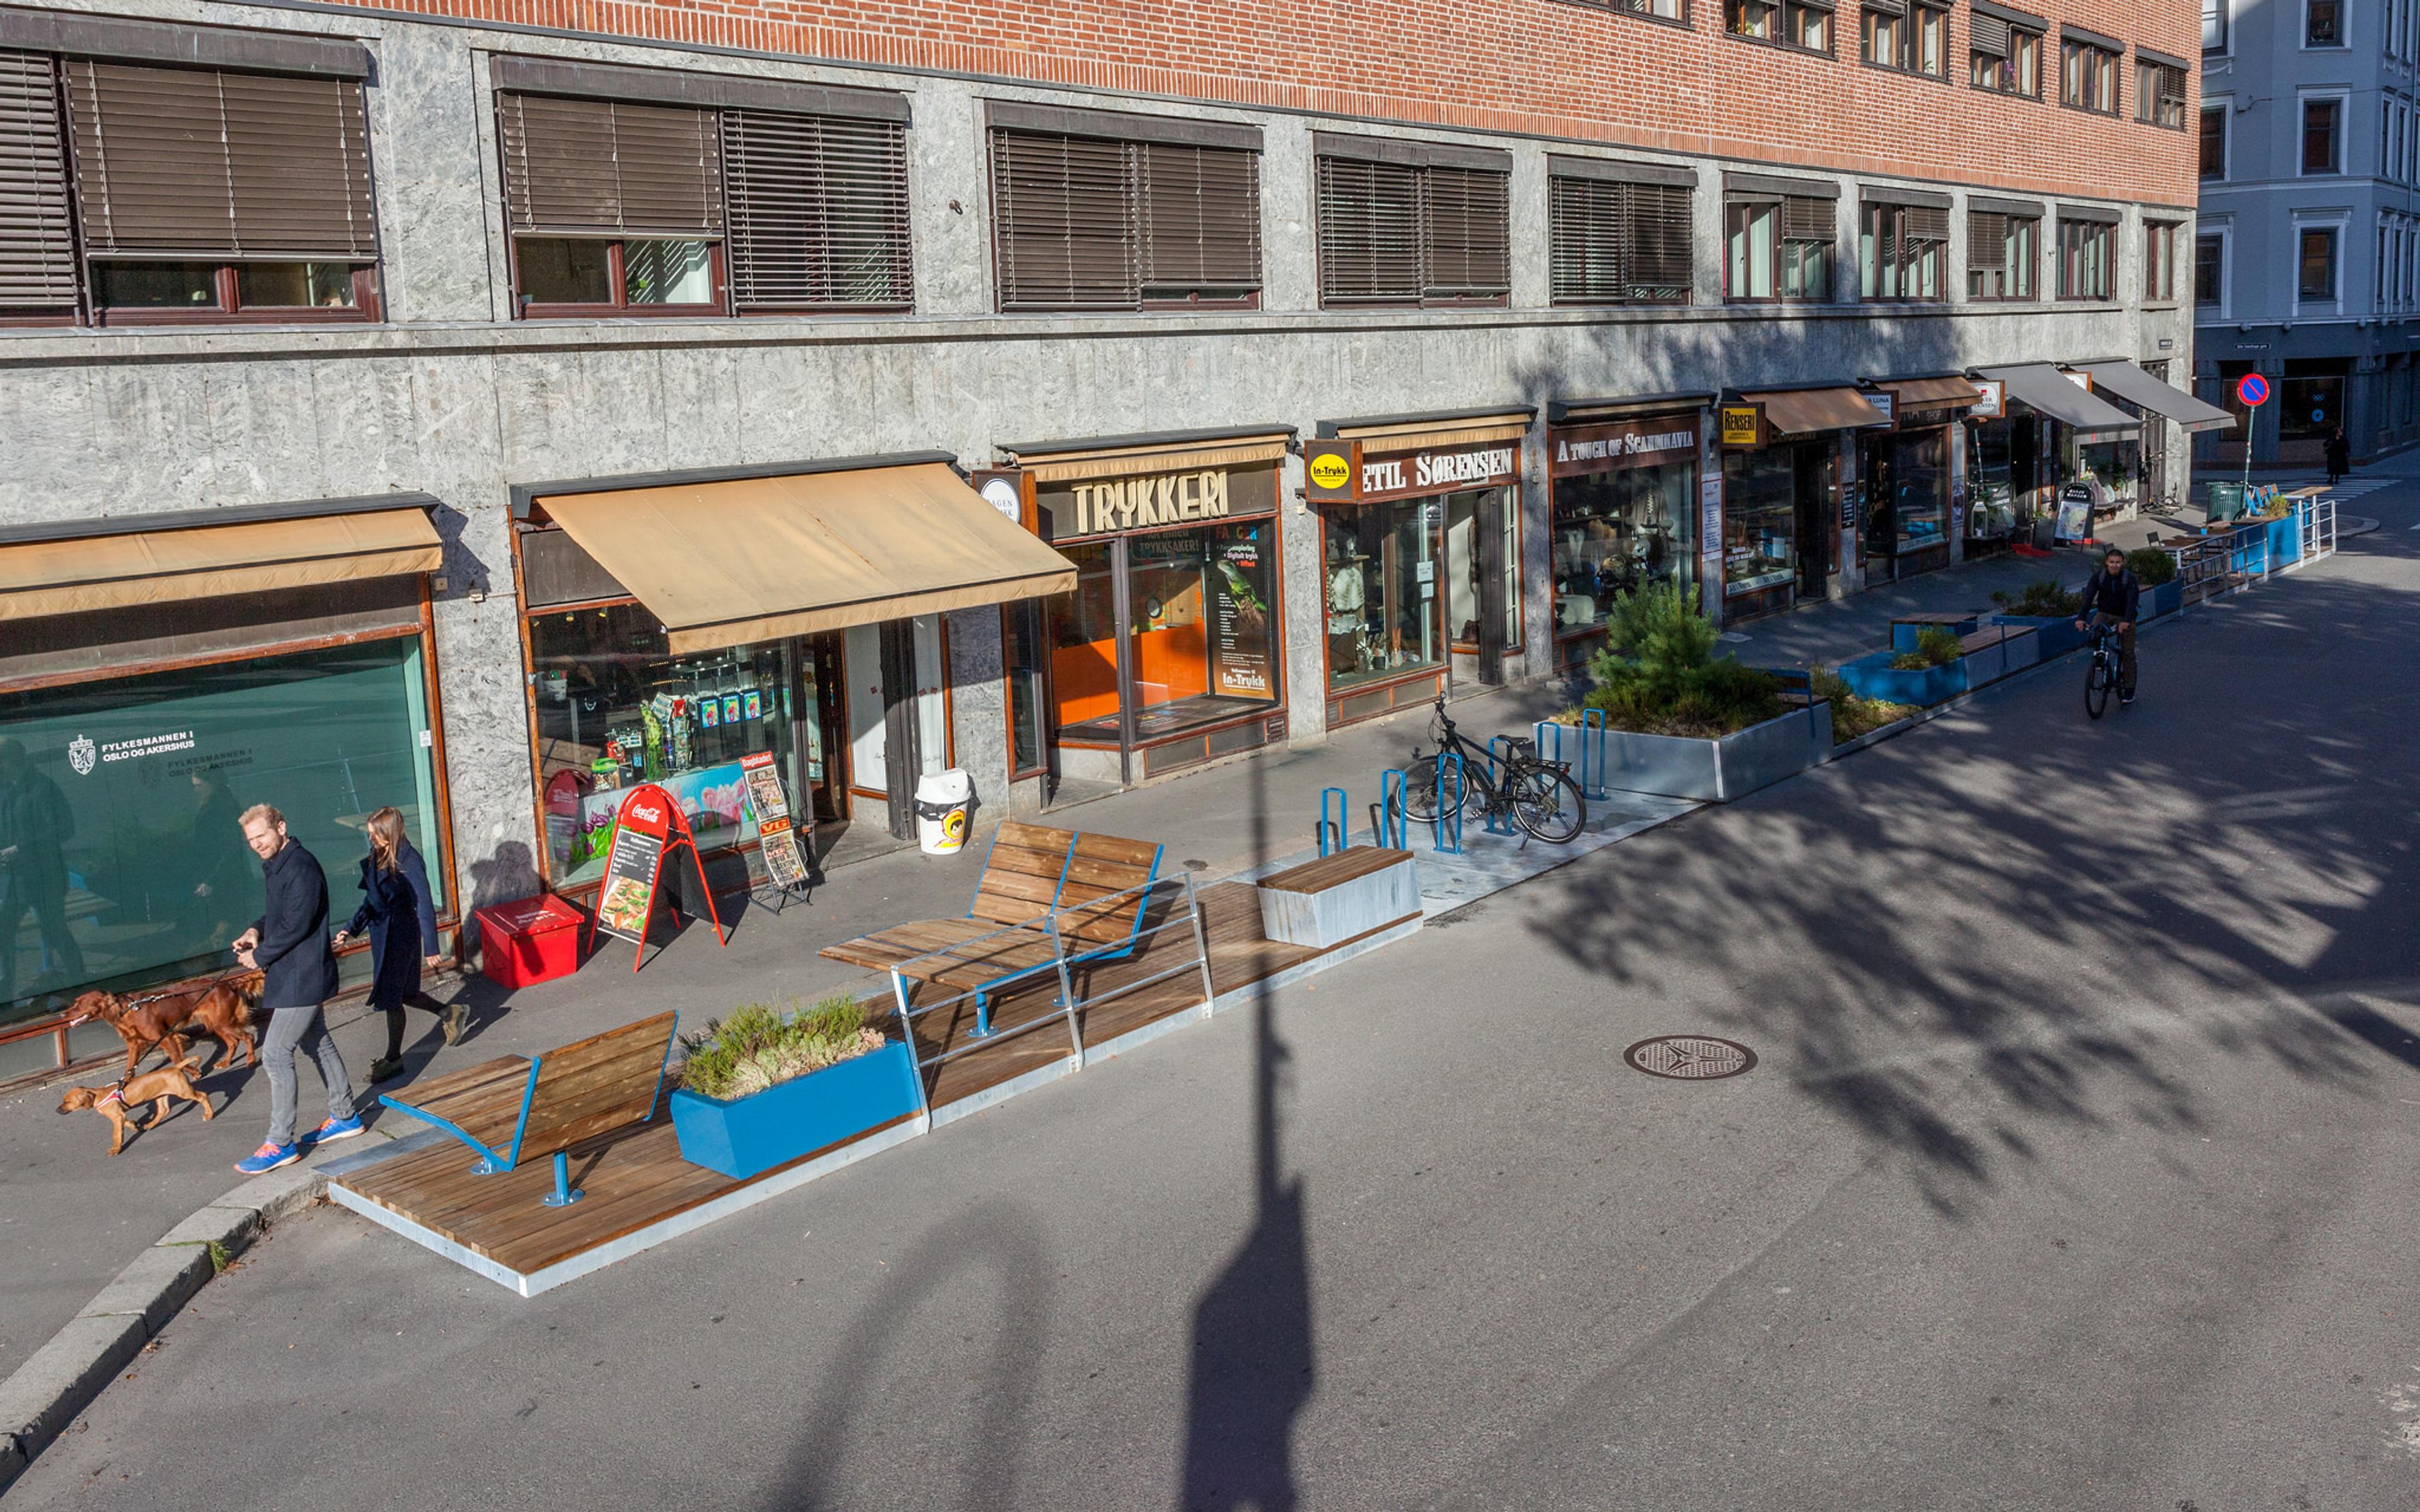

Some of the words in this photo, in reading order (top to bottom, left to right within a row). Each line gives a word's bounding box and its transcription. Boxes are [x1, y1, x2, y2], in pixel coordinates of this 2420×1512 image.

[1724, 411, 1754, 431] RENSERI
[1557, 440, 1569, 462] A
[1570, 440, 1607, 461] TOUCH
[1608, 438, 1622, 457] OF
[1624, 430, 1694, 455] SCANDINAVIA
[1313, 466, 1347, 476] In-Trykk
[1363, 461, 1407, 492] ETIL
[1415, 448, 1512, 486] SØRENSEN
[1071, 470, 1229, 534] TRYKKERI
[1223, 672, 1265, 689] In-Trykk
[101, 731, 187, 752] FYLKESMANNEN
[189, 730, 194, 738] I
[103, 750, 130, 762] OSLO
[130, 748, 146, 757] OG
[146, 740, 195, 755] AKERSHUS
[168, 750, 246, 769] FYLKESMANNEN
[170, 767, 193, 777] OSLO
[209, 757, 253, 770] AKERSHUS
[631, 803, 661, 823] Coca-Cola
[761, 819, 788, 832] VG
